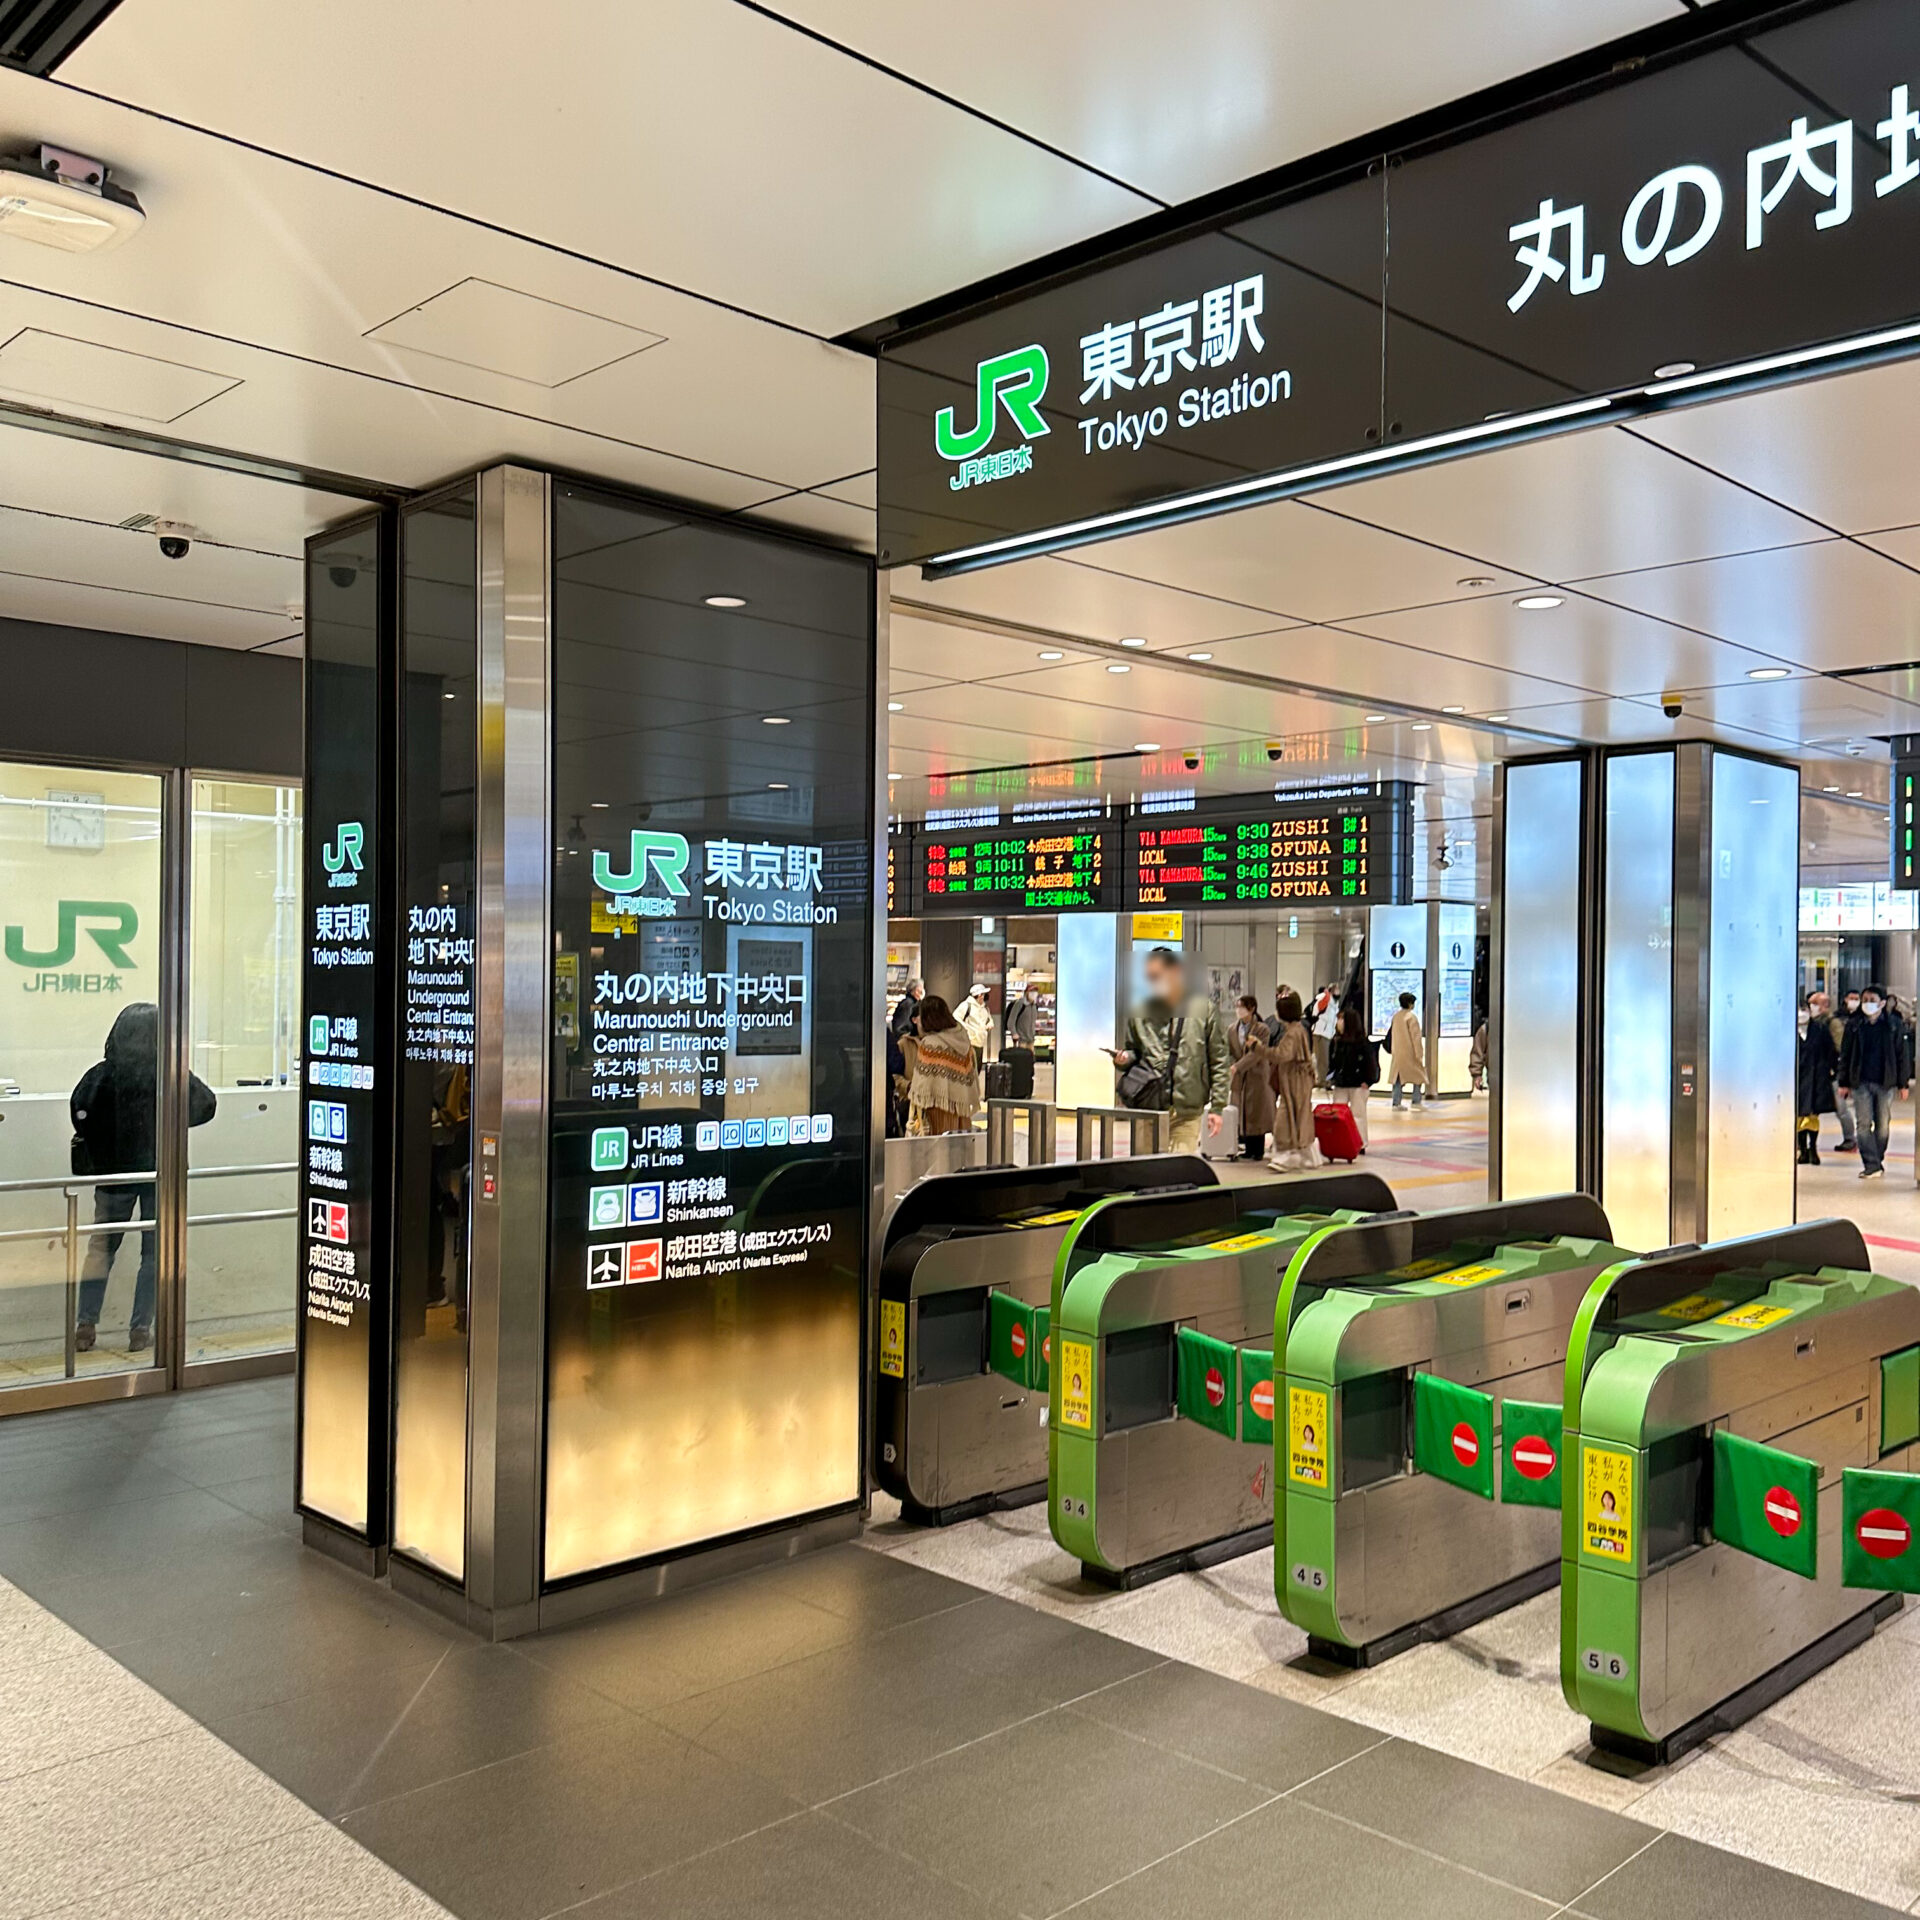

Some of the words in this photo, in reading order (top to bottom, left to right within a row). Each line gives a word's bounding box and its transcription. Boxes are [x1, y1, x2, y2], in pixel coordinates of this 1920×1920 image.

[1078, 274, 1265, 405] 東京駅
[935, 343, 1051, 461] JR
[1078, 407, 1168, 455] Tokyo
[1177, 369, 1292, 429] Station
[949, 445, 1033, 491] JR東日本
[1274, 792, 1304, 802] Yokosuka
[1304, 791, 1318, 800] Line
[1319, 788, 1351, 799] Departure
[1351, 786, 1369, 796] Time
[1139, 831, 1156, 846] VIA
[1160, 828, 1204, 845] KAMAKURA
[1236, 822, 1269, 840] 9:30
[1271, 819, 1330, 838] ZUSHI
[1360, 816, 1368, 833] 1
[322, 821, 364, 873] JR
[974, 842, 992, 857] 12両
[994, 840, 1025, 856] 10:02
[1093, 834, 1102, 849] 4
[1139, 849, 1167, 866] LOCAL
[1236, 843, 1269, 860] 9:38
[1360, 837, 1368, 853] 1
[592, 829, 691, 897] JR
[703, 837, 824, 893] 東京駅
[887, 864, 895, 879] 3
[975, 860, 992, 874] 9両
[994, 857, 1024, 873] 10:11
[1093, 852, 1102, 868] 2
[1139, 867, 1156, 883] VIA
[1160, 866, 1203, 882] KAMAKURA
[1236, 863, 1269, 880] 9:46
[1271, 860, 1330, 879] ZUSHI
[1360, 858, 1367, 874] 1
[887, 880, 895, 895] 3
[974, 876, 992, 891] 12両
[994, 874, 1025, 890] 10:32
[1093, 870, 1102, 886] 4
[1138, 887, 1167, 903] LOCAL
[1236, 883, 1269, 900] 9:49
[1360, 879, 1367, 895] 1
[606, 895, 677, 917] JR東日本
[703, 896, 766, 926] Tokyo
[772, 900, 838, 925] Station
[315, 903, 370, 942] 東京駅
[408, 904, 457, 933] 丸の内
[4, 899, 139, 969] JR
[311, 947, 340, 969] Tokyo
[341, 946, 374, 965] Station
[22, 972, 123, 993] JR東日本
[407, 969, 464, 985] Marunouchi
[594, 970, 807, 1005] 丸の内地下中央口
[407, 989, 470, 1008] Underground
[406, 1007, 441, 1023] Central
[593, 1009, 691, 1030] Marunouchi
[695, 1009, 793, 1032] Underground
[315, 1027, 325, 1044] JR
[330, 1017, 358, 1041] JR線
[329, 1043, 340, 1057] JR
[340, 1044, 358, 1058] Lines
[593, 1033, 655, 1053] Central
[659, 1033, 730, 1052] Entrance
[592, 1056, 719, 1077] 丸之内地下中央入口
[591, 1081, 663, 1101] 마루노우치
[669, 1079, 696, 1097] 지하
[702, 1077, 728, 1096] 중앙
[733, 1077, 759, 1095] 입구
[632, 1123, 683, 1150] JR線
[702, 1129, 715, 1143] JT
[725, 1129, 739, 1141] JO
[748, 1127, 761, 1140] JK
[771, 1125, 784, 1139] JY
[794, 1123, 806, 1137] JC
[815, 1122, 828, 1136] JU
[309, 1145, 343, 1173] 新幹線
[600, 1140, 619, 1159] JR
[631, 1155, 649, 1170] JR
[651, 1152, 684, 1168] Lines
[309, 1171, 348, 1190] Shinkansen
[667, 1175, 728, 1205] 新幹線
[666, 1204, 734, 1223] Shinkansen
[665, 1229, 738, 1262] 成田空港
[309, 1244, 356, 1276] 成田空港
[665, 1265, 700, 1280] Narita
[703, 1258, 741, 1276] Airport
[743, 1256, 772, 1271] (Narita
[773, 1249, 808, 1268] Express)
[308, 1290, 330, 1308] Narita
[330, 1295, 354, 1314] Airport
[1064, 1499, 1072, 1512] 3
[1077, 1503, 1085, 1516] 4
[1297, 1568, 1306, 1582] 4
[1313, 1573, 1322, 1586] 5
[1588, 1654, 1600, 1670] 5
[1609, 1659, 1621, 1675] 6
